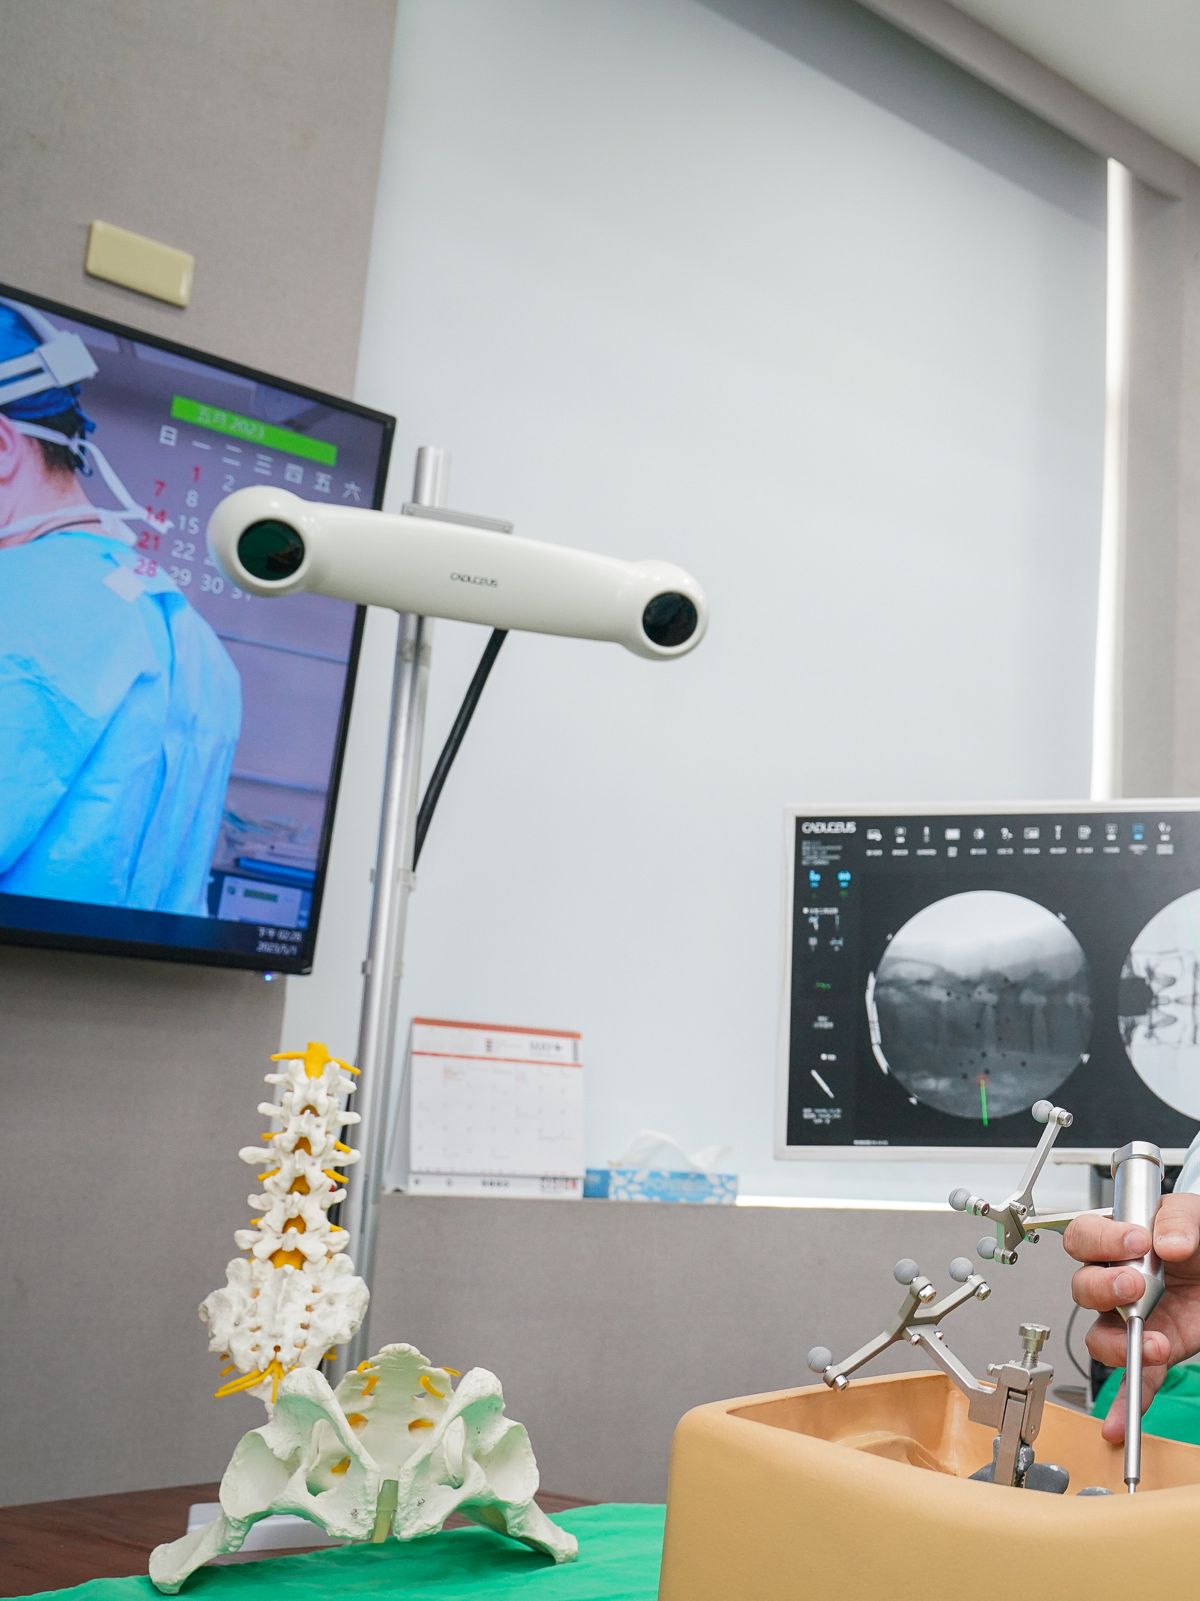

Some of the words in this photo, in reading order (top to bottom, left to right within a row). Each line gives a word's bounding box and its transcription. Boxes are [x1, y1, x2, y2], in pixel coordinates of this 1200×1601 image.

[160, 424, 178, 447] 日
[222, 444, 242, 467] 二
[253, 453, 275, 477] 三
[284, 462, 304, 485] 四
[313, 471, 333, 494] 五
[341, 481, 361, 502] 六
[192, 465, 201, 483] 1
[222, 474, 235, 493] 2
[154, 480, 167, 498] 7
[186, 489, 199, 508] 8
[179, 514, 200, 535] 15
[136, 531, 161, 552] 21
[171, 540, 196, 561] 22
[134, 557, 157, 578] 28
[169, 566, 192, 587] 29
[200, 573, 225, 595] 30
